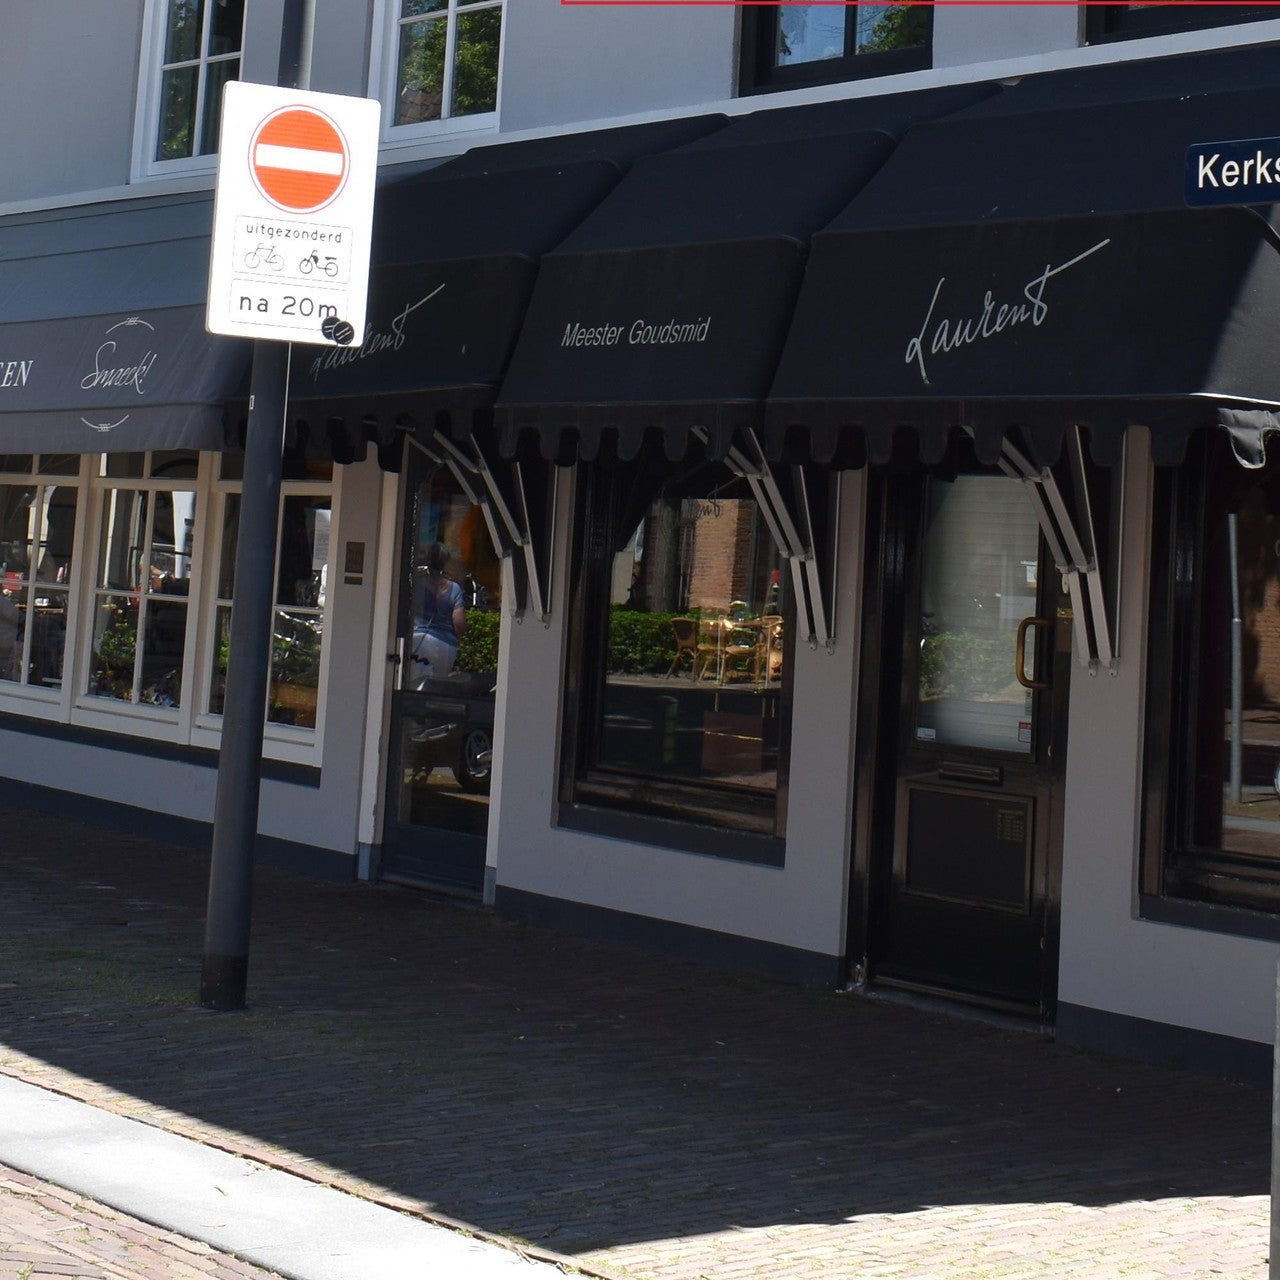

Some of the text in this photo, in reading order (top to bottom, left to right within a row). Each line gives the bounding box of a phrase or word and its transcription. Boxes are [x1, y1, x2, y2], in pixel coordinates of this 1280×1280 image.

[246, 223, 342, 244] uitgezonderd
[239, 296, 269, 313] na
[905, 238, 1111, 385] Laurent
[561, 316, 712, 347] Meester Goudsmid
